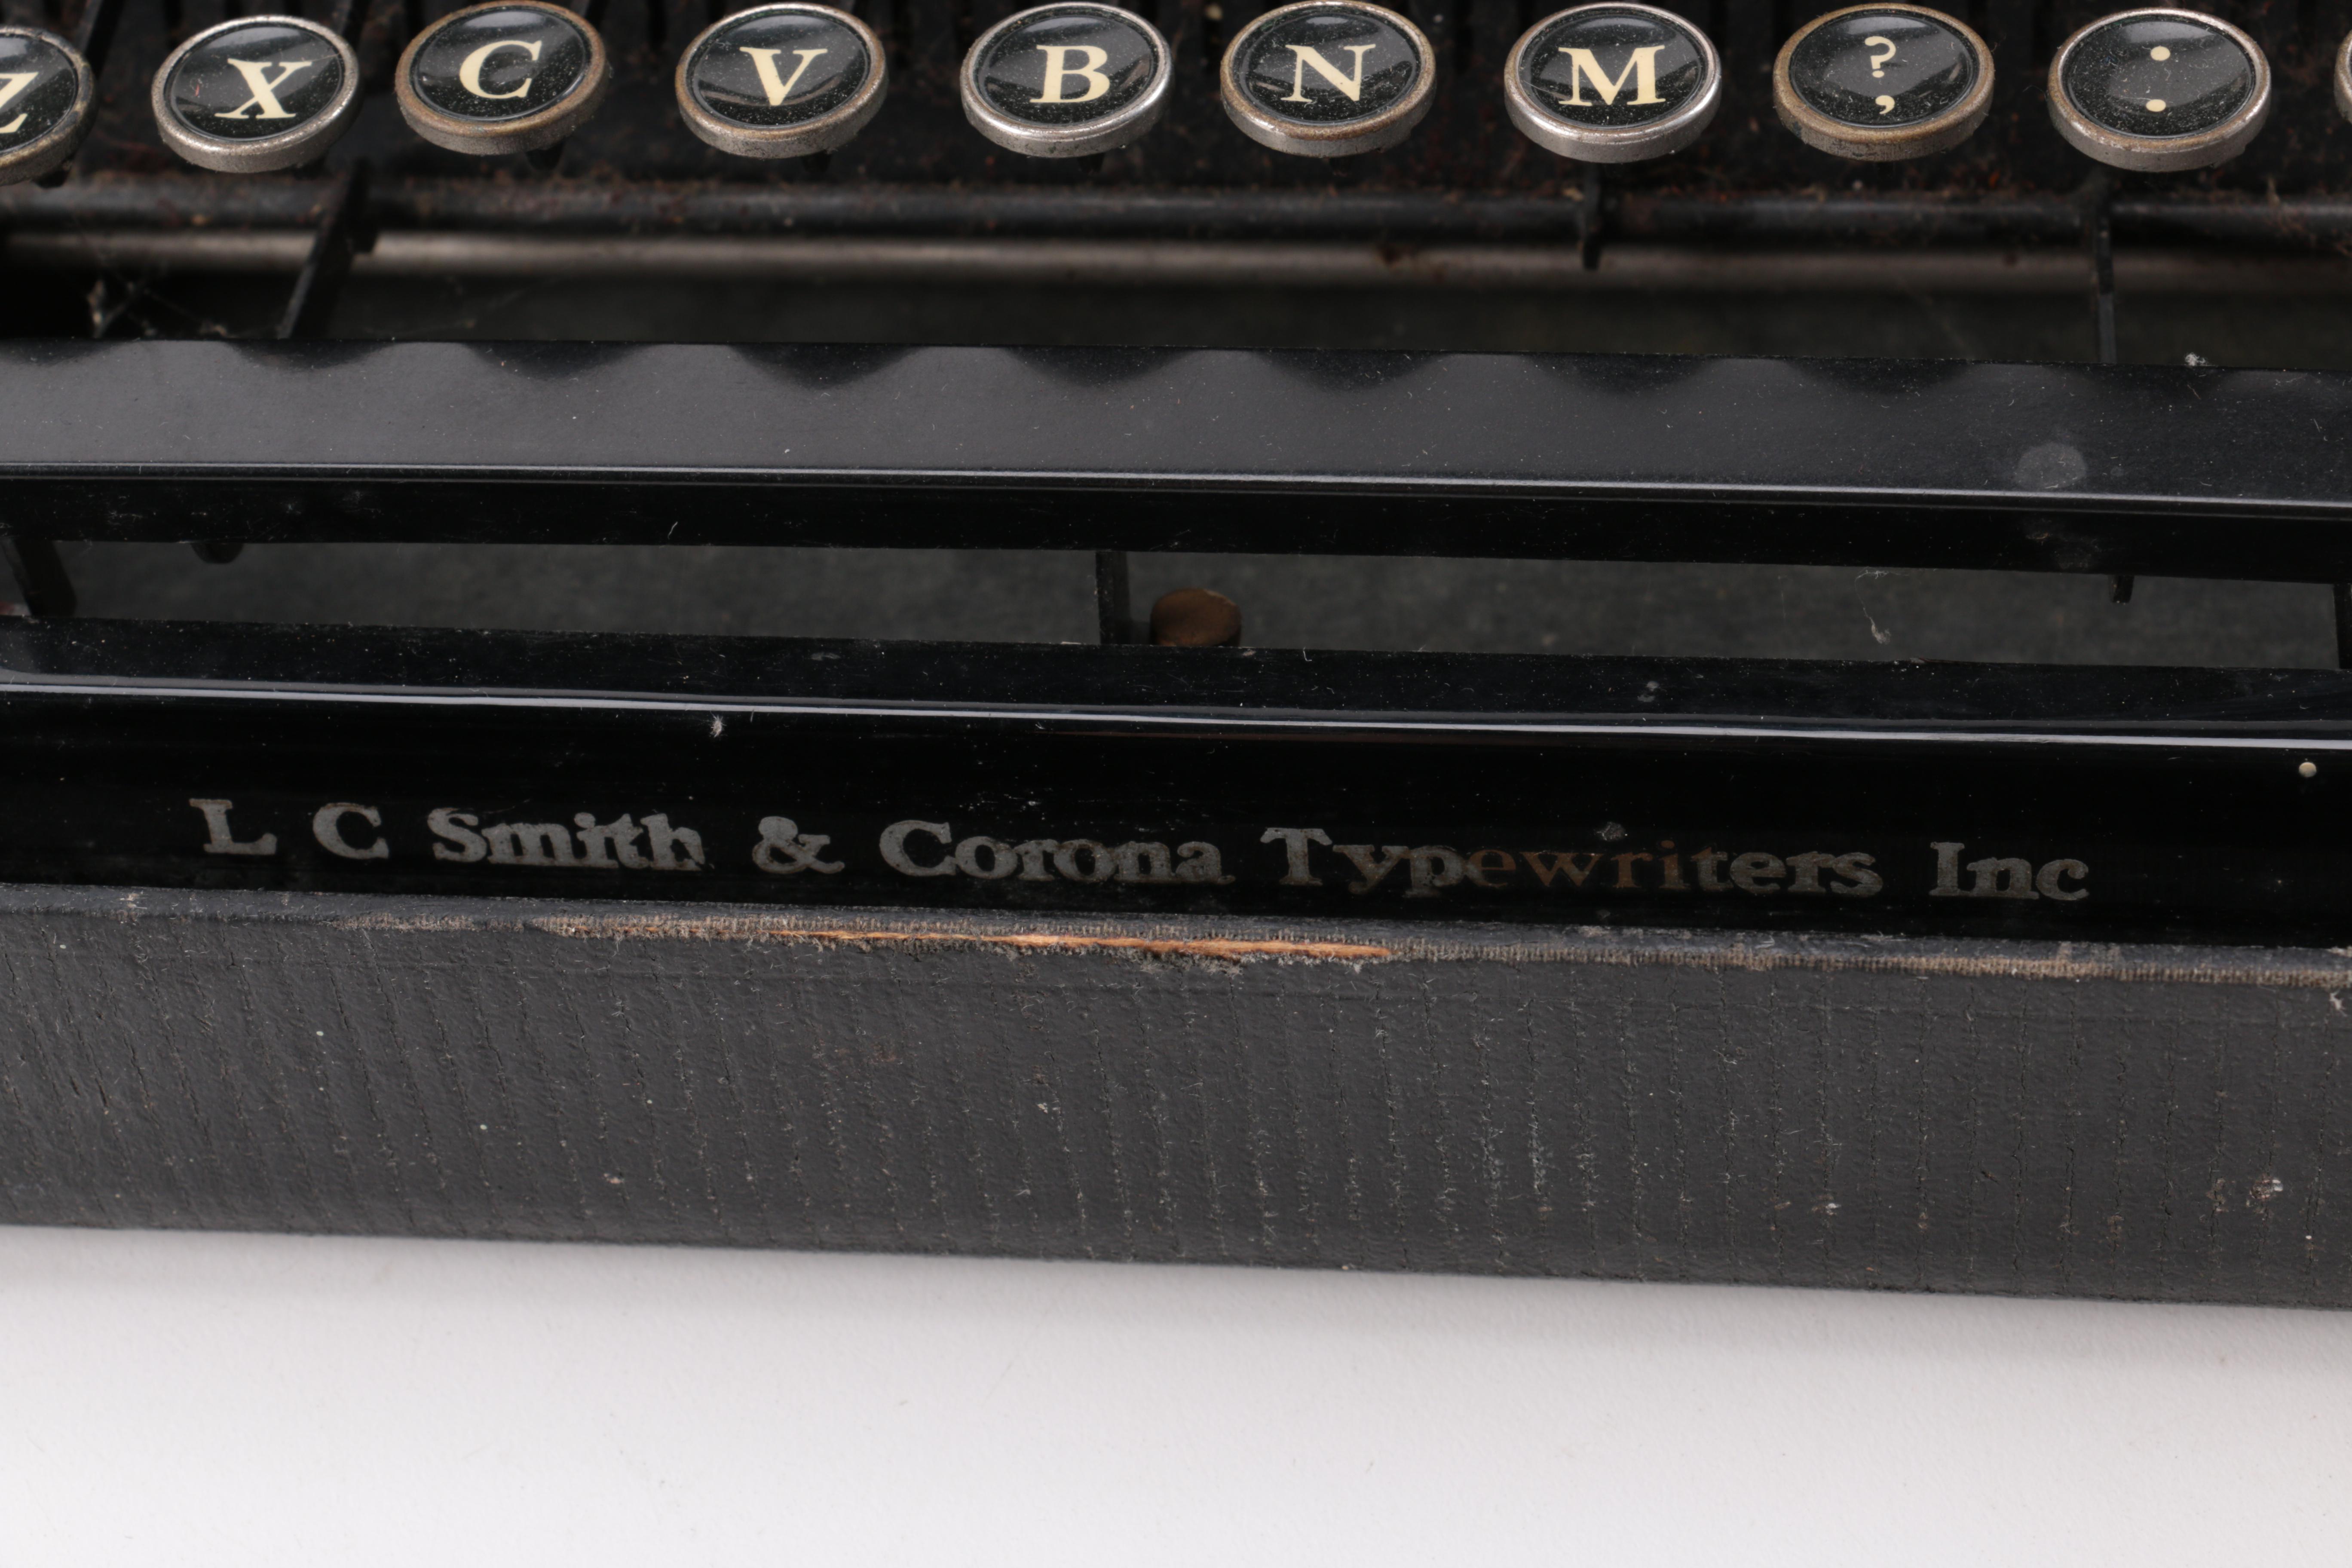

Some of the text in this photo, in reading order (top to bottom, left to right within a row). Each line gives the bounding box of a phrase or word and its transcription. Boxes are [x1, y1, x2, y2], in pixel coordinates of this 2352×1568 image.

[459, 40, 543, 99] C
[740, 46, 828, 106] V
[1030, 44, 1110, 103] B
[1281, 43, 1376, 103] N
[1559, 44, 1666, 106] M
[1864, 35, 1896, 77] ?
[215, 58, 312, 119] X
[189, 798, 2090, 901] L C Smith & Corona Typewriters Inc
